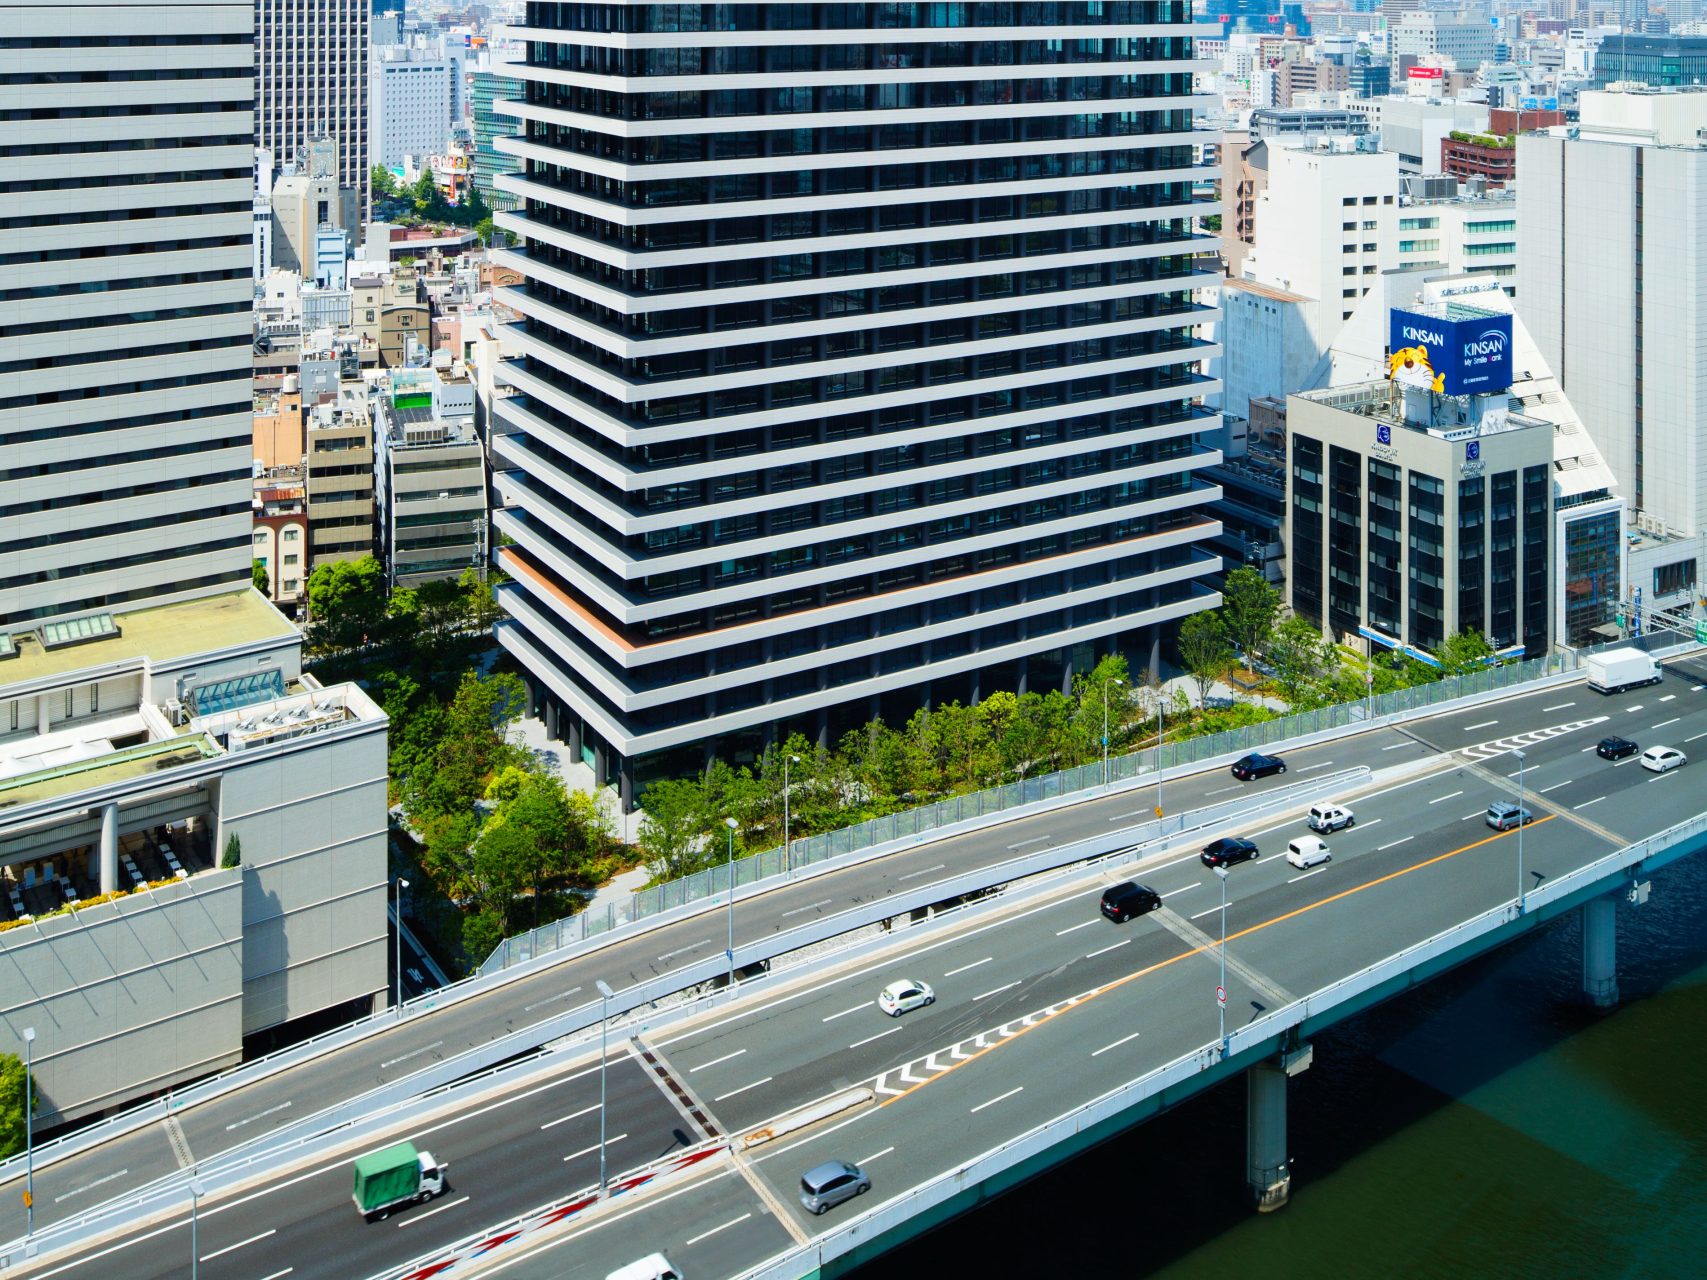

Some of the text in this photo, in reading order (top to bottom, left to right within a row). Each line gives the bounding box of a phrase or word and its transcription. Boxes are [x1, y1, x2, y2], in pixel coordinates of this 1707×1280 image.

[1403, 326, 1444, 347] KINSAN
[1464, 339, 1502, 357] KINSAN
[1464, 358, 1472, 366] My
[1473, 356, 1488, 365] Smile
